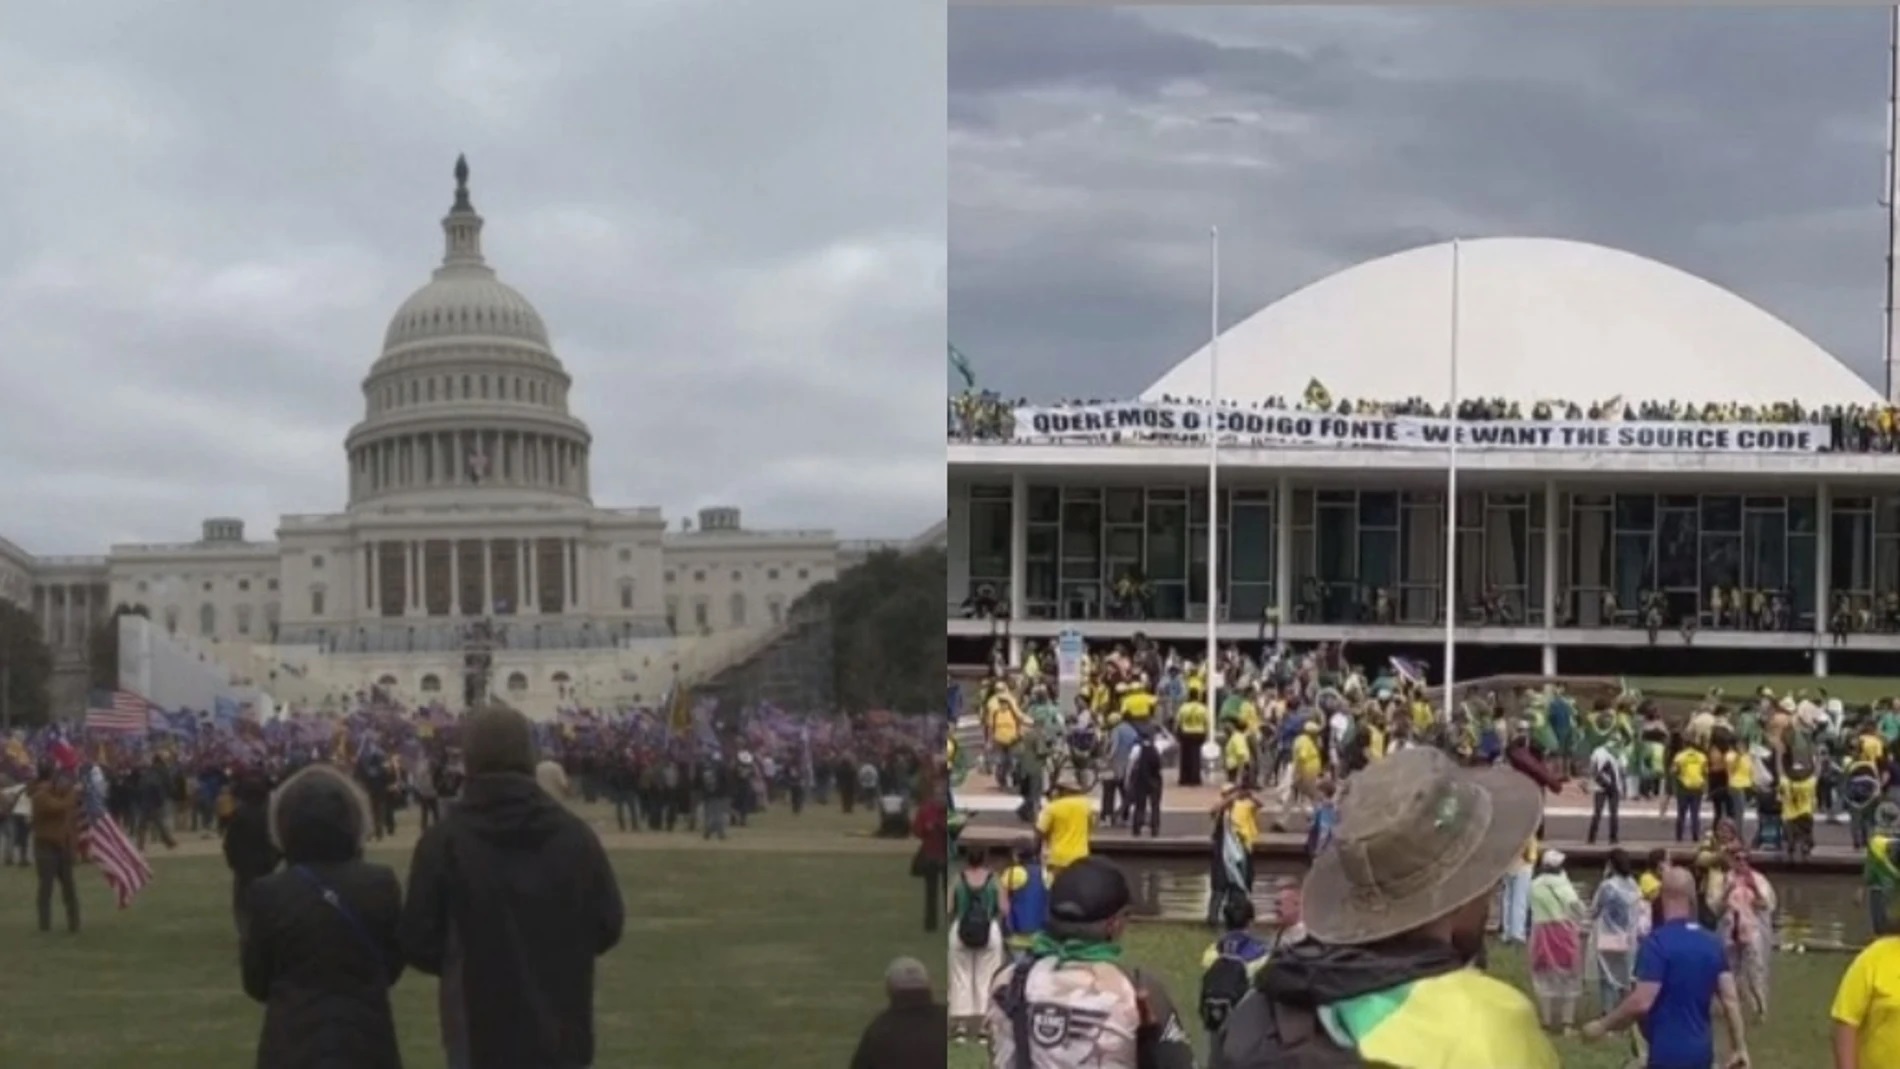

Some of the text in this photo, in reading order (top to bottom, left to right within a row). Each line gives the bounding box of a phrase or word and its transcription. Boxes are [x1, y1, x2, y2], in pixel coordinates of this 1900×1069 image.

[1033, 409, 1174, 434] QUEREMOS
[1182, 411, 1200, 430] O
[1321, 417, 1398, 441] FONTE
[1422, 424, 1464, 443] WE
[1472, 426, 1552, 446] WANT
[1560, 427, 1609, 446] THE
[1618, 428, 1729, 449] SOURCE
[1736, 430, 1811, 449] CODE
